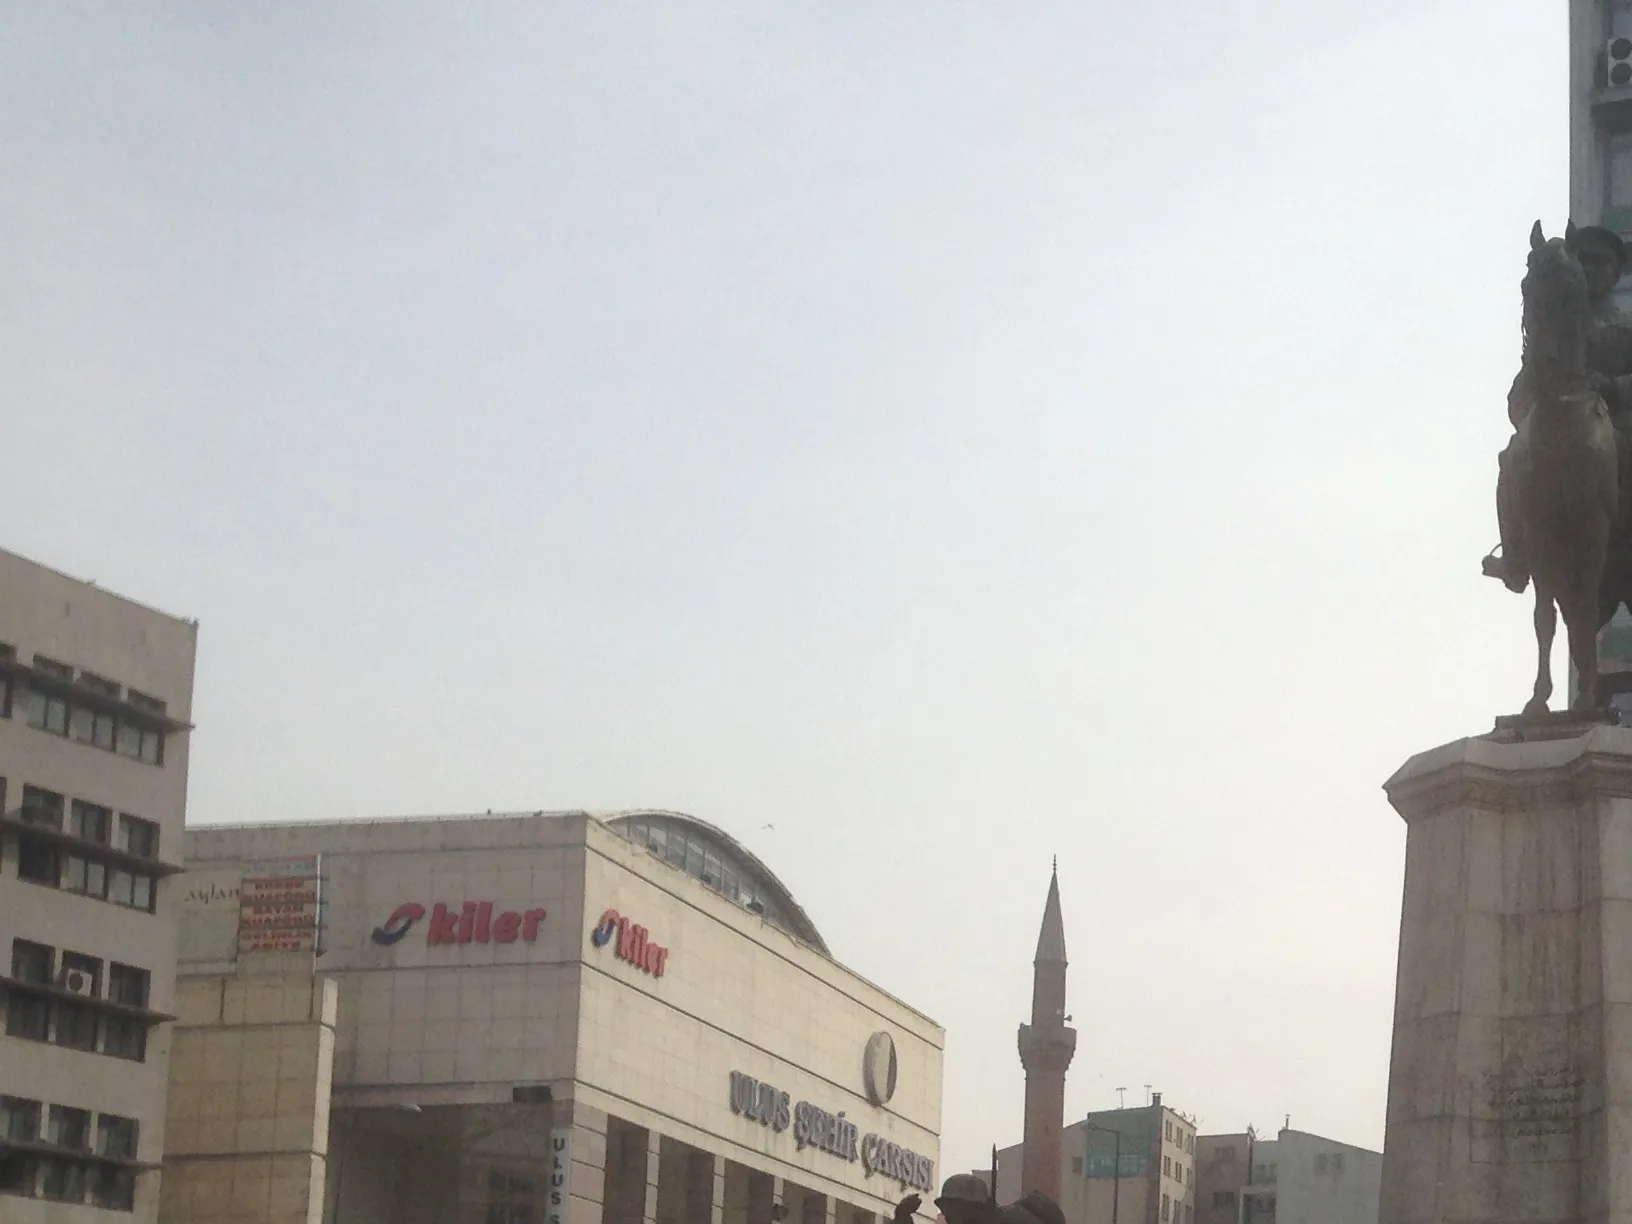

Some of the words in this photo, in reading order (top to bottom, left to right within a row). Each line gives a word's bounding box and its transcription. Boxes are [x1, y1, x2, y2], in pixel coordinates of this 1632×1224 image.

[427, 901, 547, 948] kiler
[615, 916, 669, 979] kiler
[729, 1069, 791, 1134] ULUS
